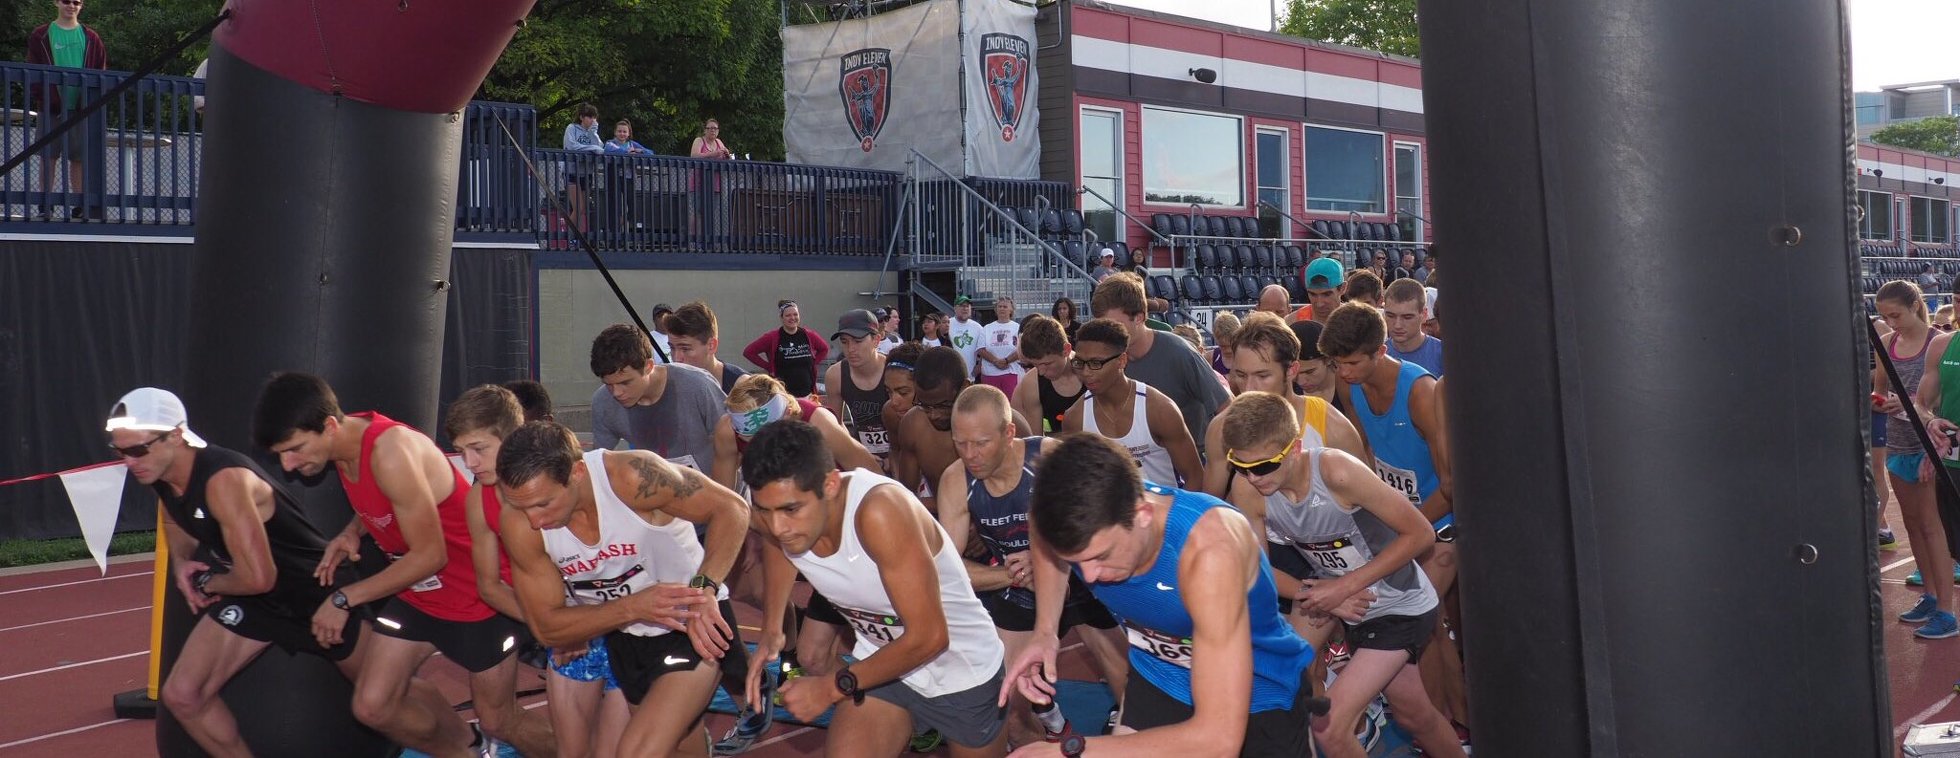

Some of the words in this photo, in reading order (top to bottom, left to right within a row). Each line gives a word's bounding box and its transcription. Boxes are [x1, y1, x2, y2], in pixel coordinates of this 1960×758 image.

[985, 36, 1004, 51] INDY
[1004, 37, 1028, 56] ELEVEN
[844, 53, 862, 71] INDY
[862, 51, 887, 65] ELEVEN
[1379, 468, 1414, 495] 1416
[980, 514, 1011, 526] FLEET
[1312, 551, 1348, 569] 295
[595, 583, 632, 602] 252
